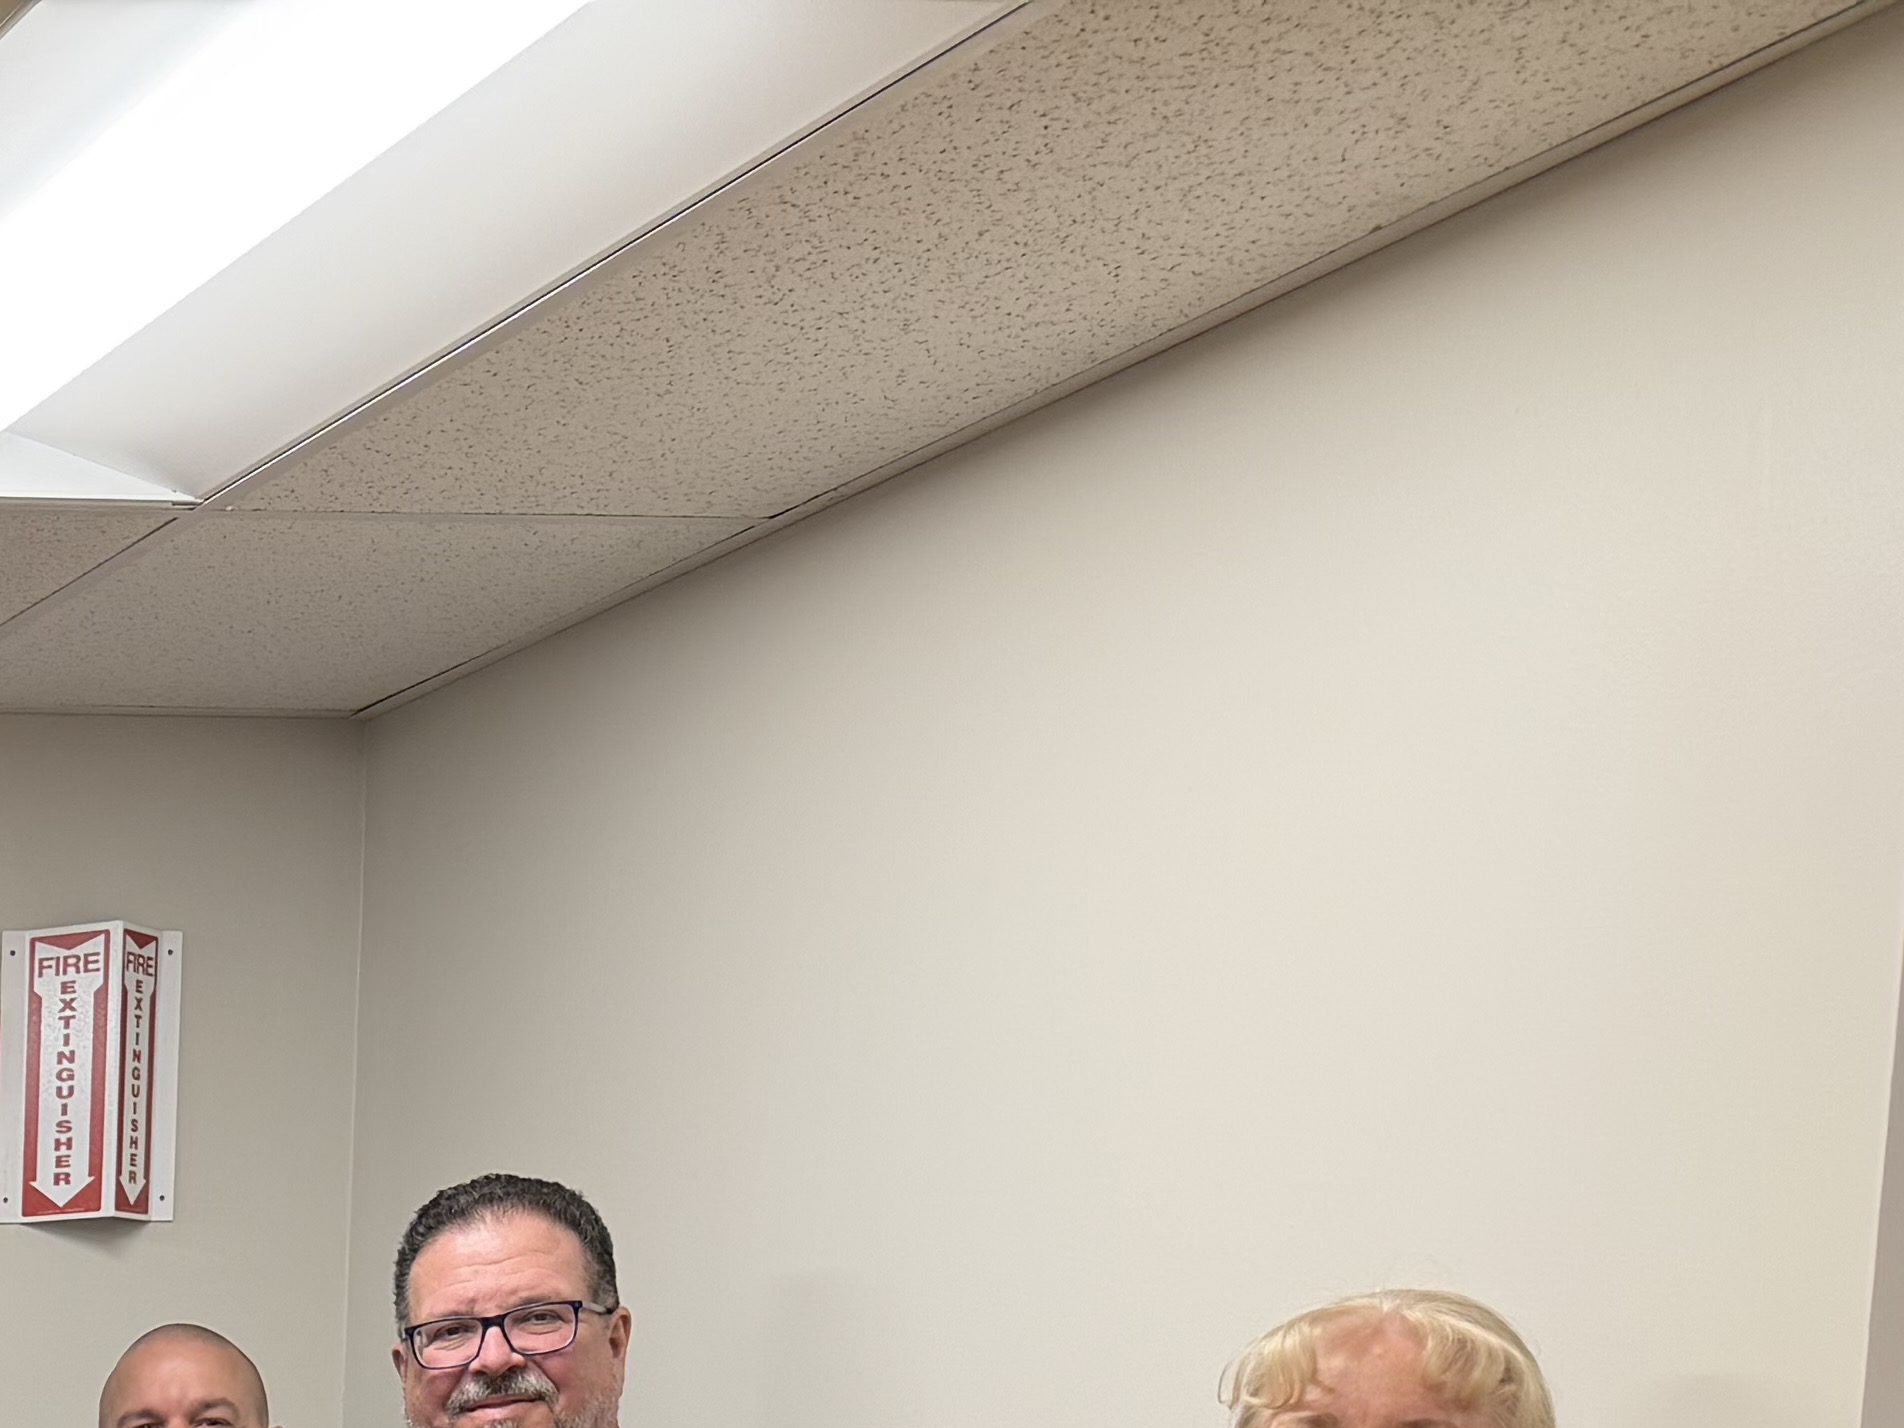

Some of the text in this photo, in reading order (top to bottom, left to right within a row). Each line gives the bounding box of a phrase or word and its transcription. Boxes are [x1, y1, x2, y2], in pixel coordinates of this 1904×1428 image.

[37, 952, 102, 978] FIRE
[126, 951, 155, 977] FIRE
[53, 980, 76, 1186] EXTINGUISHER
[128, 980, 144, 1185] EXTINGUISHER
